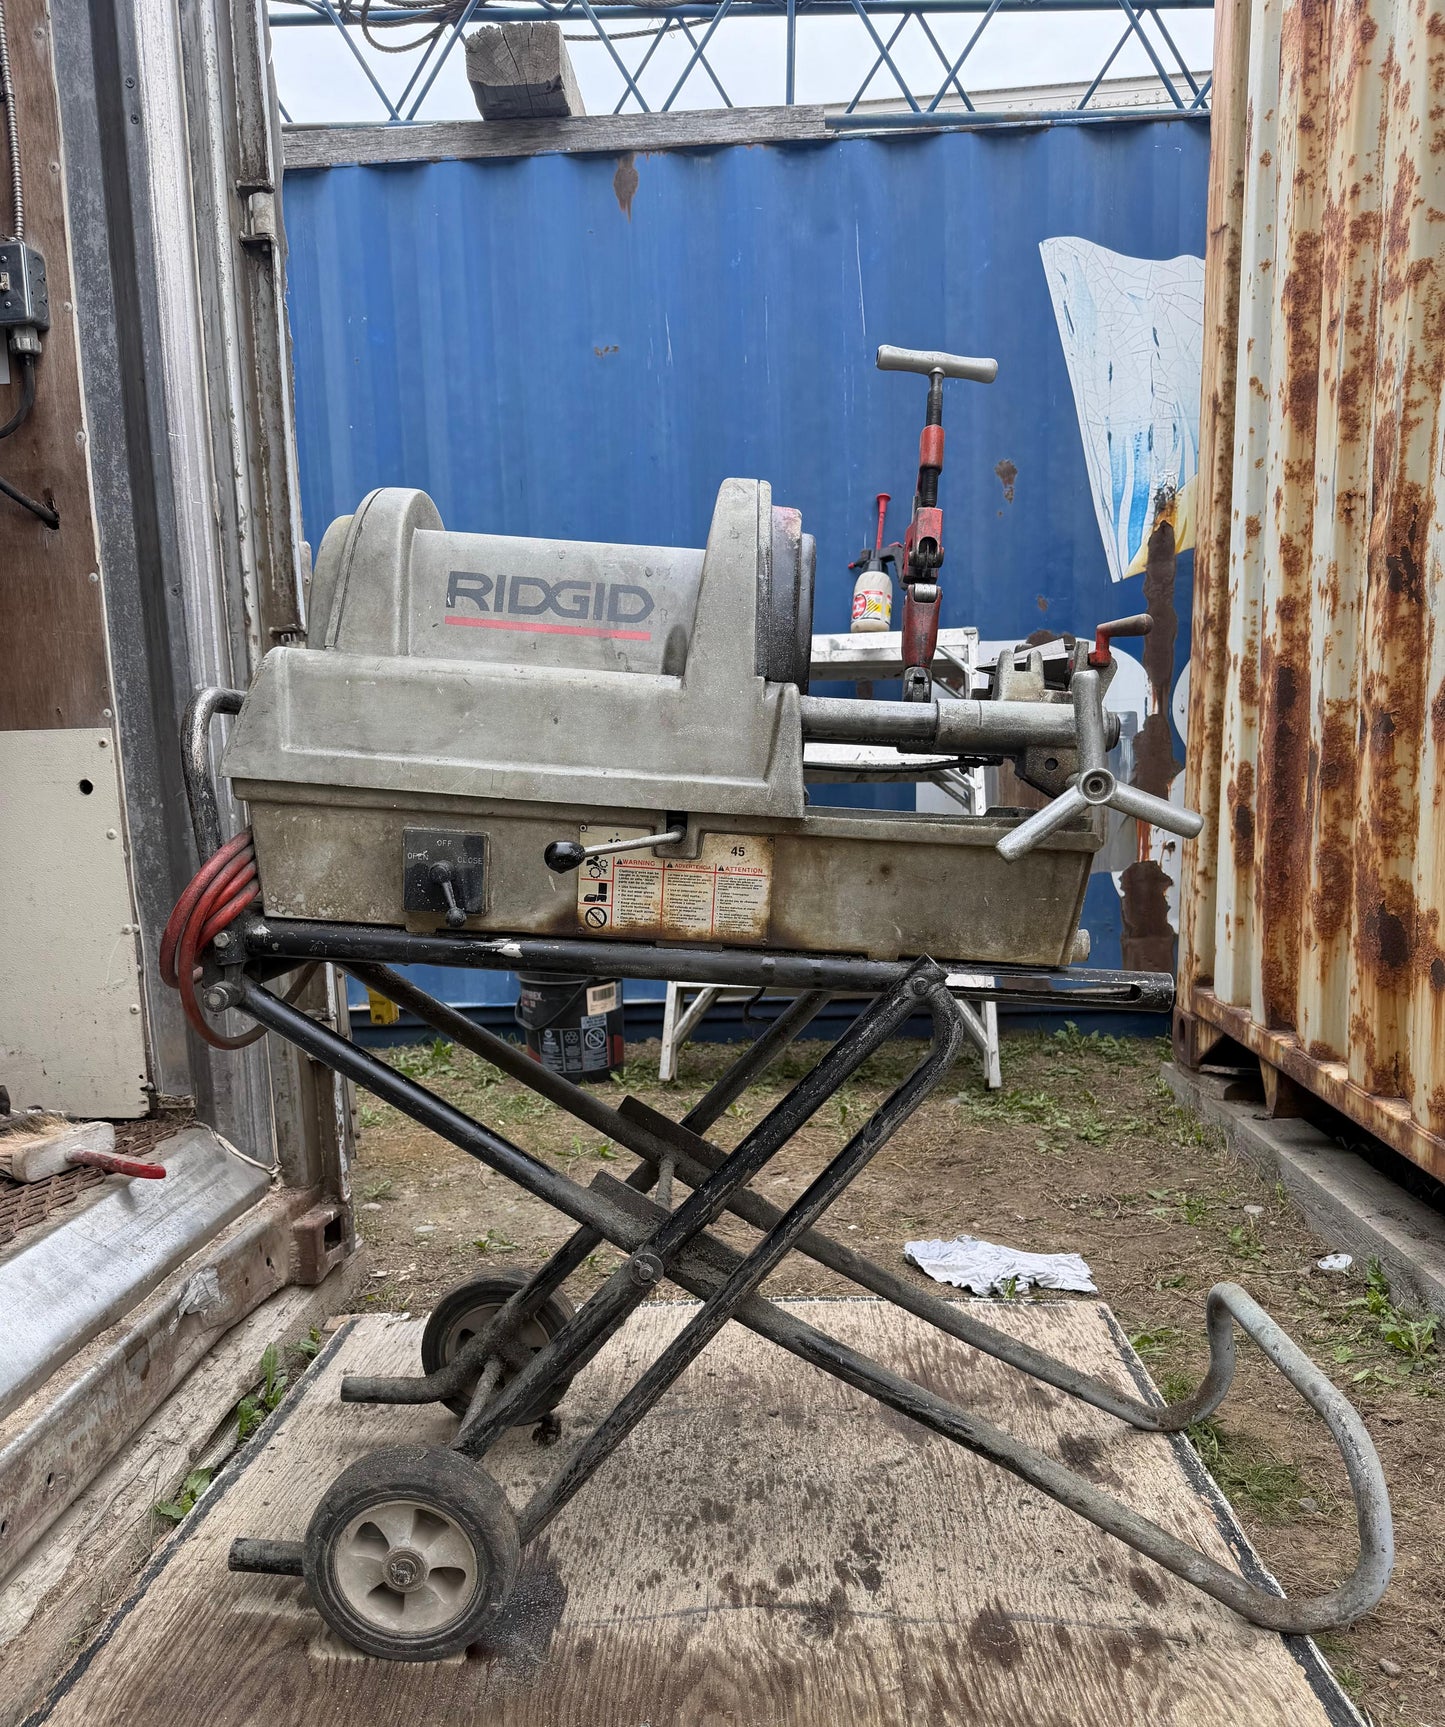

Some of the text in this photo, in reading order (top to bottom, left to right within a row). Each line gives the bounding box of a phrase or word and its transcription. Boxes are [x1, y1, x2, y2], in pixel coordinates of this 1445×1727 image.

[446, 571, 655, 623] RIDGID
[436, 839, 452, 847] OFF
[730, 846, 745, 857] 45
[407, 852, 429, 861] OPEN
[457, 856, 483, 865] CLOSE
[622, 859, 656, 867] WARNING
[725, 866, 763, 874] ATTENTION
